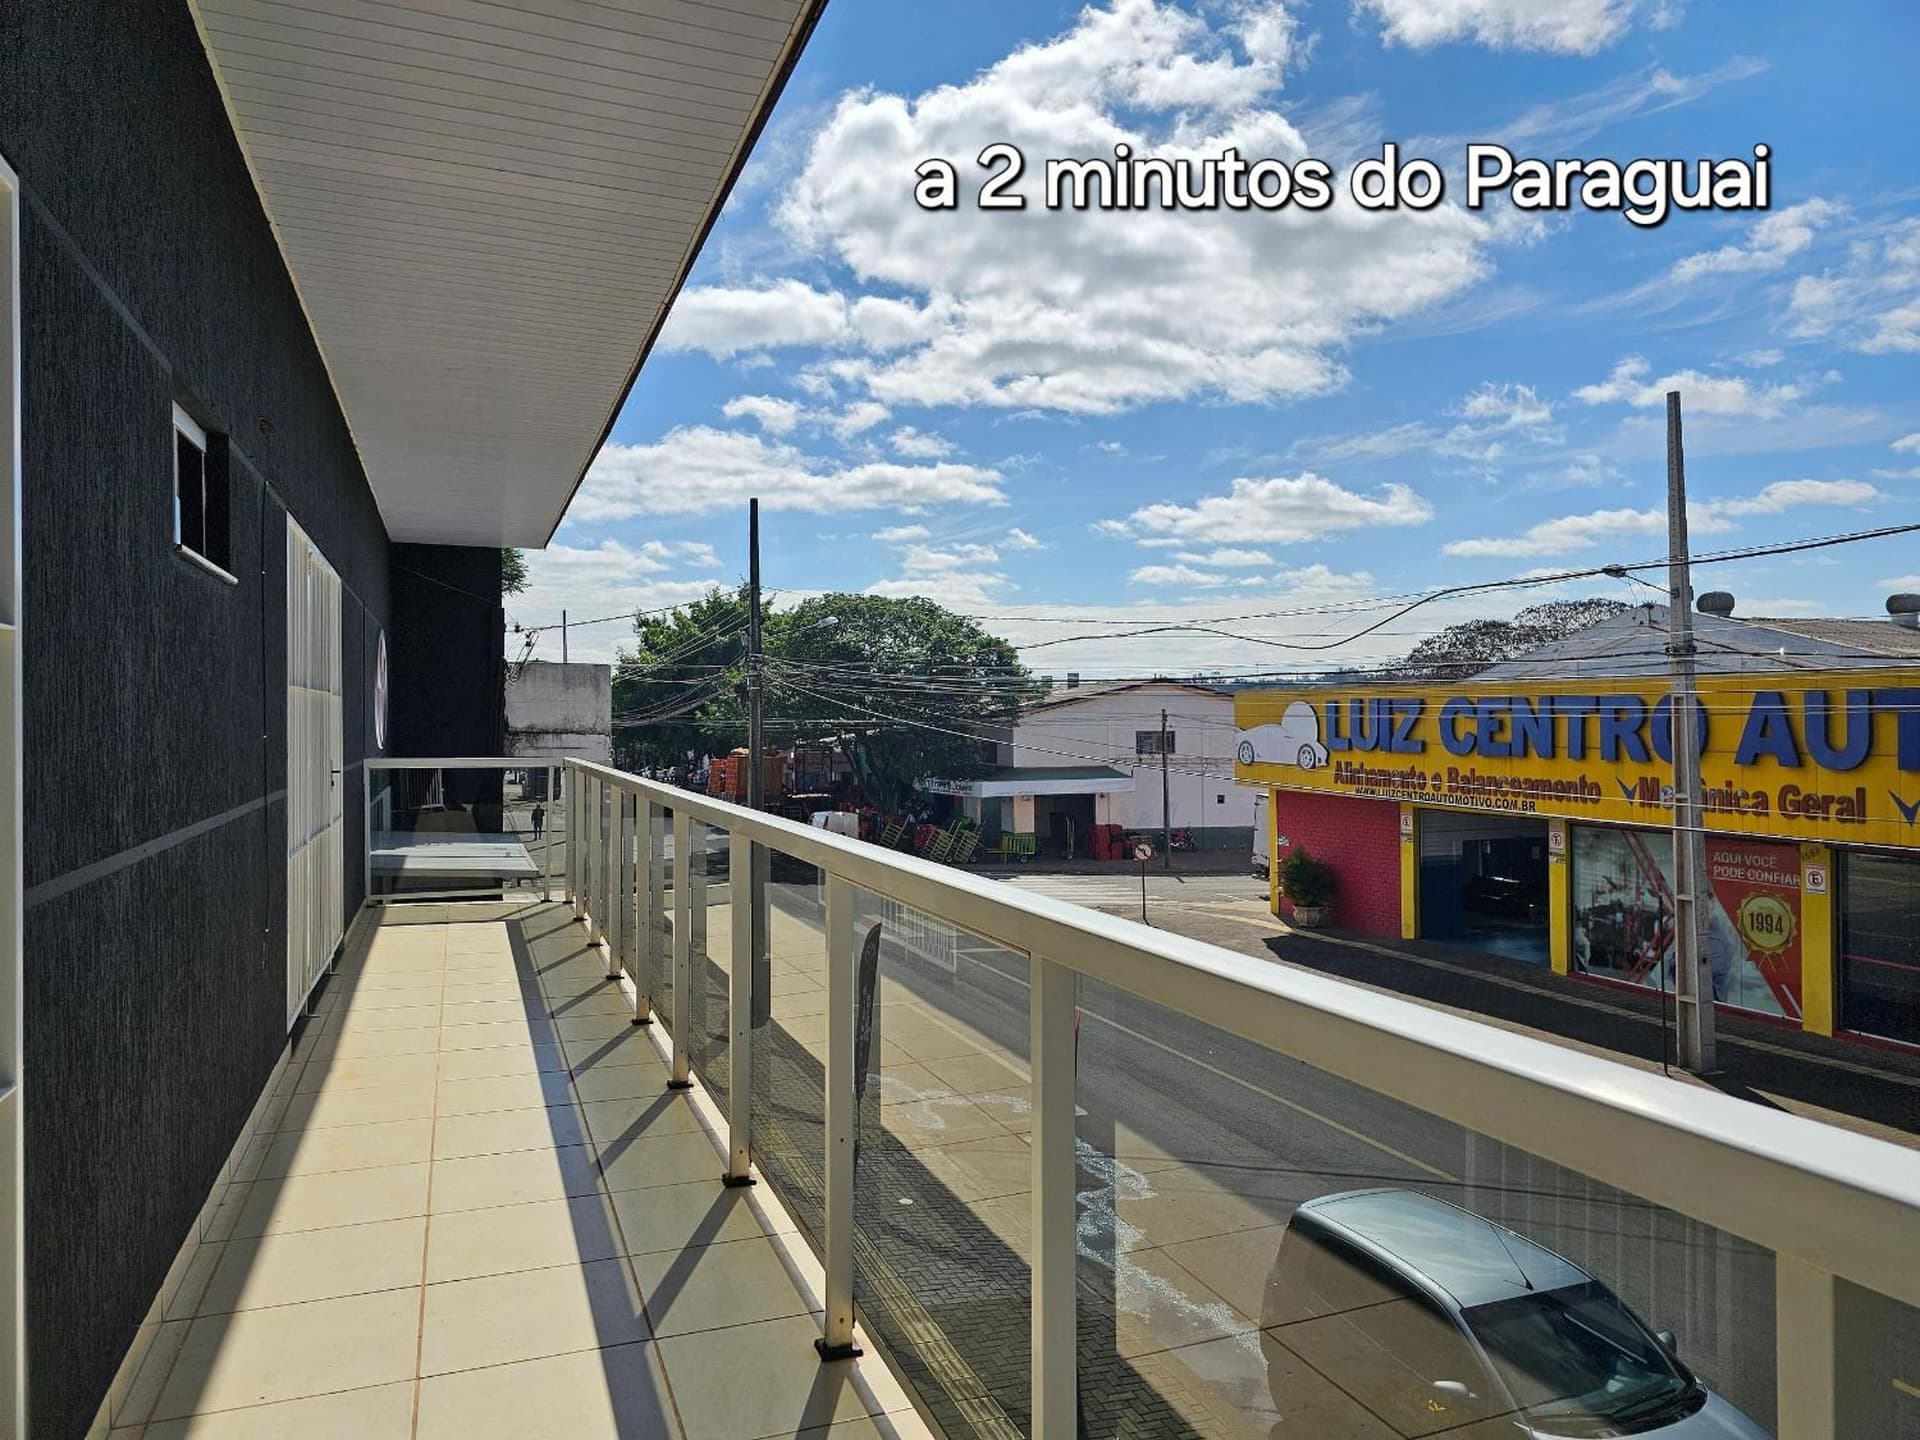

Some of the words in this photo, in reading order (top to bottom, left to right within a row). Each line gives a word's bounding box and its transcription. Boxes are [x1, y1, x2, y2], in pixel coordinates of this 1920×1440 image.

[1326, 697, 1427, 754] LUIZ
[1439, 694, 1709, 765] CENTRO
[1333, 760, 1427, 790] Alinhamento
[1431, 771, 1442, 792] e
[1778, 784, 1866, 824] Geral
[1713, 851, 1742, 864] AQUI
[1713, 865, 1745, 879] PODE
[1749, 912, 1783, 935] 1994
